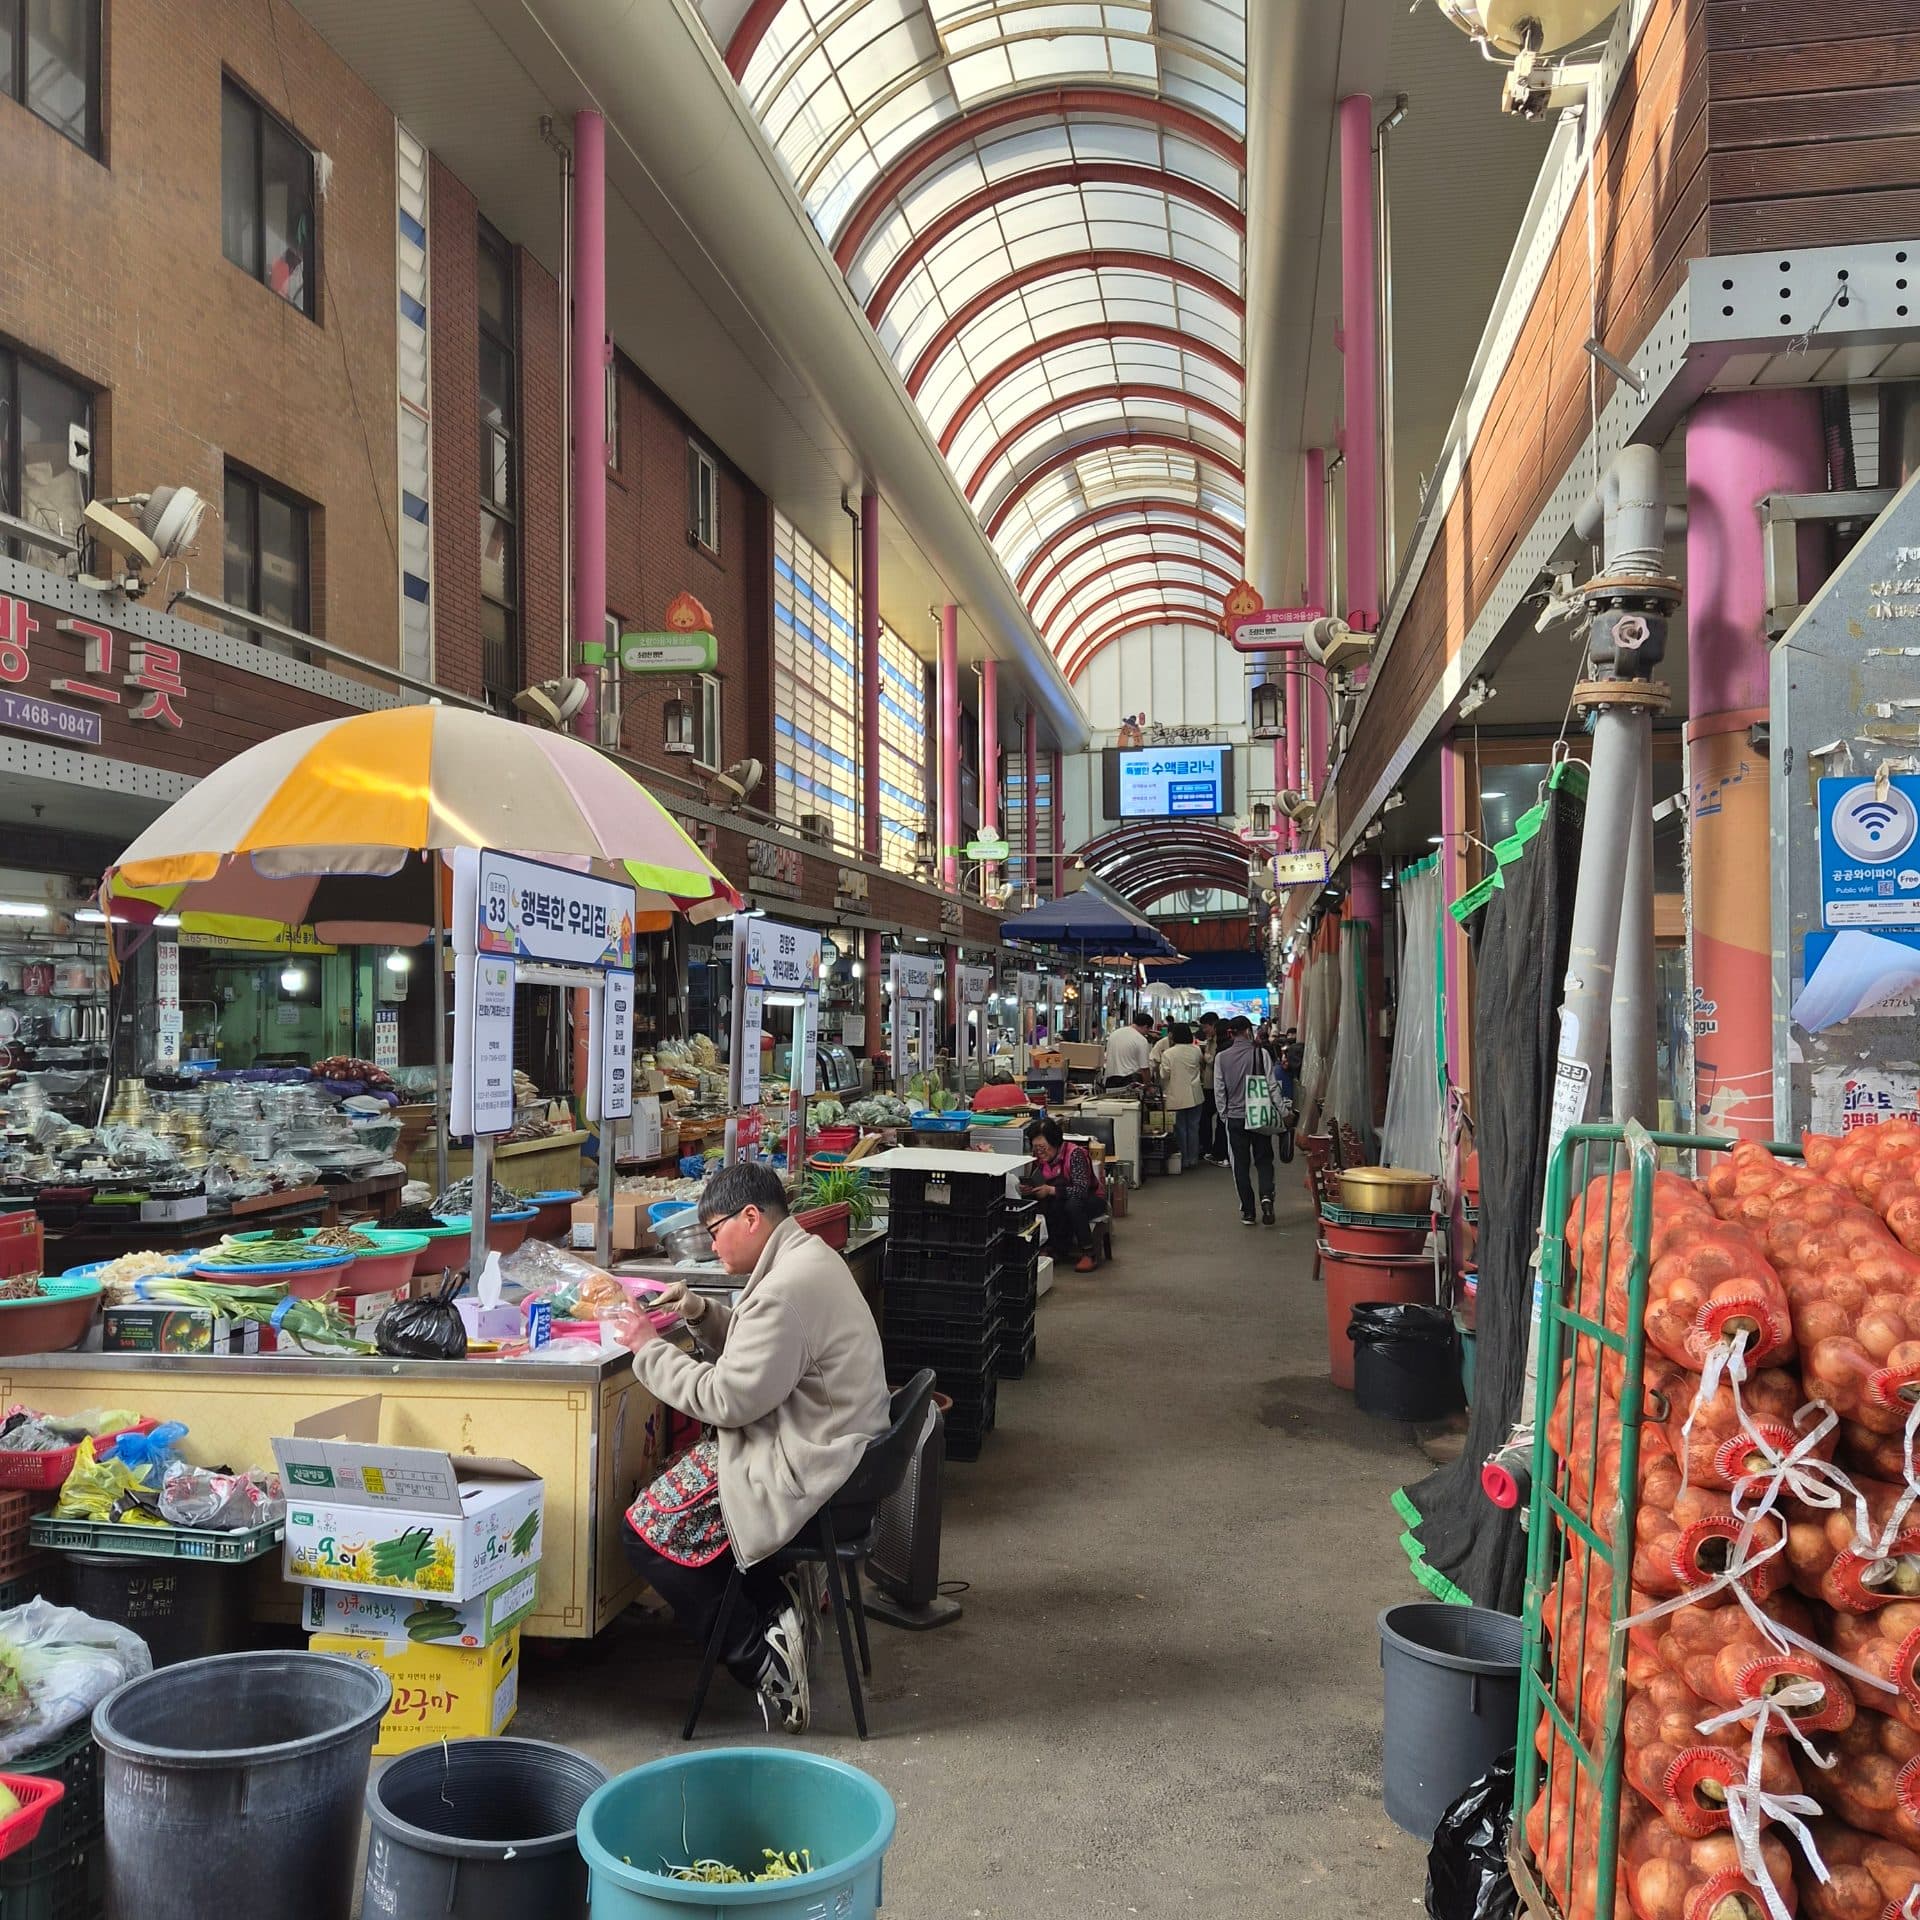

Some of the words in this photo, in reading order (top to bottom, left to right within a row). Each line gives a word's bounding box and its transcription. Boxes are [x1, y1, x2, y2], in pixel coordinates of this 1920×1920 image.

[6, 699, 93, 736] T.468-0847
[1152, 760, 1214, 775] 수액클리닉
[1832, 868, 1896, 882] 공공와이파이
[1900, 875, 1919, 883] Free
[1836, 886, 1857, 894] Public
[489, 897, 505, 922] 33
[521, 889, 565, 932] 행복한
[568, 901, 606, 939] 우리집
[751, 949, 760, 966] 34
[295, 1545, 318, 1562] 싱글
[318, 1536, 356, 1567] 오이
[472, 1551, 487, 1569] 싱글
[486, 1535, 507, 1560] 오이
[391, 1688, 459, 1721] 고구마
